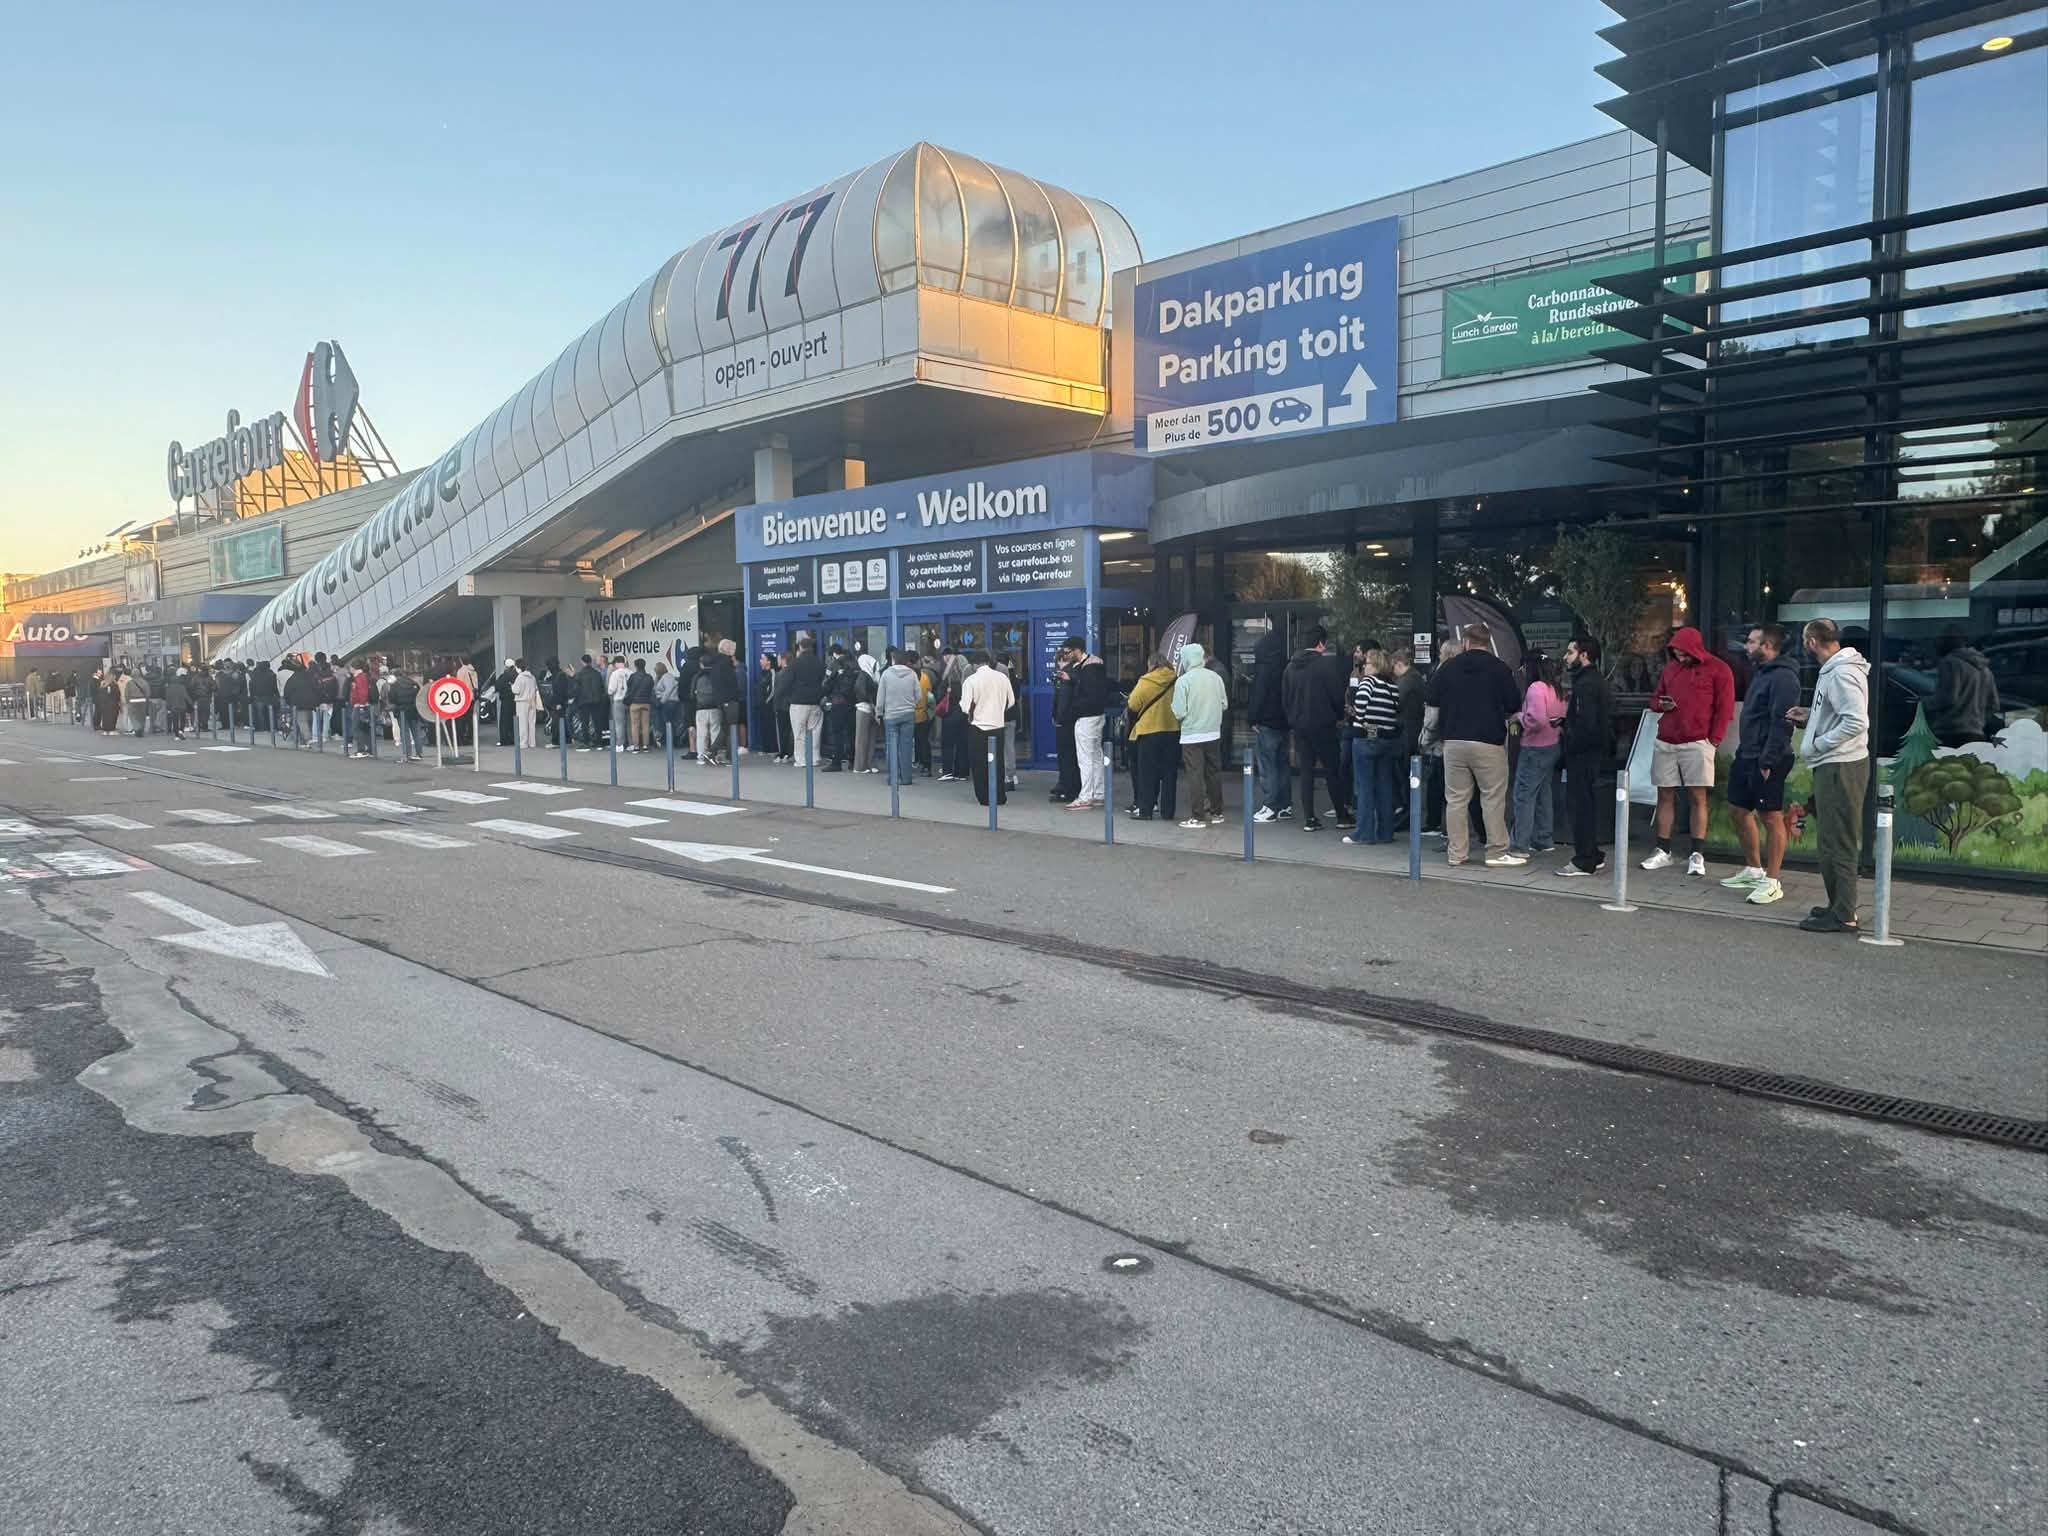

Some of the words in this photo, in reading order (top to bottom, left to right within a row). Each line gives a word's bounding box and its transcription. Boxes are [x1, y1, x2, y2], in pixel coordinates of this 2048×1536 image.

[1159, 260, 1364, 334] Dakparking
[1549, 298, 1640, 325] Rundsstove
[1452, 325, 1480, 340] Lunch
[1482, 319, 1518, 336] Garden
[1531, 331, 1539, 345] à
[1561, 318, 1606, 341] bereid
[715, 356, 756, 389] open
[770, 331, 828, 369] ouvert
[1158, 337, 1288, 388] Parking
[1299, 314, 1366, 361] toit
[1155, 417, 1180, 430] Meer
[1182, 413, 1202, 425] dan
[1207, 403, 1261, 437] 500
[1165, 432, 1186, 444] Plus
[1188, 430, 1202, 440] de
[168, 408, 287, 502] Carrefour
[763, 508, 887, 546] Bienvenue
[917, 481, 1047, 527] Welkom
[907, 553, 915, 563] Je
[917, 551, 938, 562] online
[939, 549, 974, 561] aankopen
[995, 545, 1010, 555] Vos
[1011, 543, 1042, 553] courses
[1043, 541, 1054, 550] en
[1055, 537, 1076, 550] ligne
[910, 568, 919, 577] op
[920, 565, 963, 576] carrefour.be
[964, 563, 972, 572] of
[998, 560, 1010, 569] sur
[1011, 555, 1060, 568] carrefour.be
[1061, 553, 1073, 563] ou
[905, 581, 916, 590] via
[916, 579, 926, 589] de
[927, 577, 960, 589] Carrefour
[962, 576, 977, 588] app
[999, 573, 1011, 583] via
[1012, 571, 1031, 583] l'app
[1032, 569, 1073, 580] Carrefour
[590, 608, 645, 632] Welkom
[651, 618, 692, 633] Welcome
[5, 622, 70, 642] Auto
[602, 637, 660, 655] Bienvenue
[439, 689, 462, 706] 20
